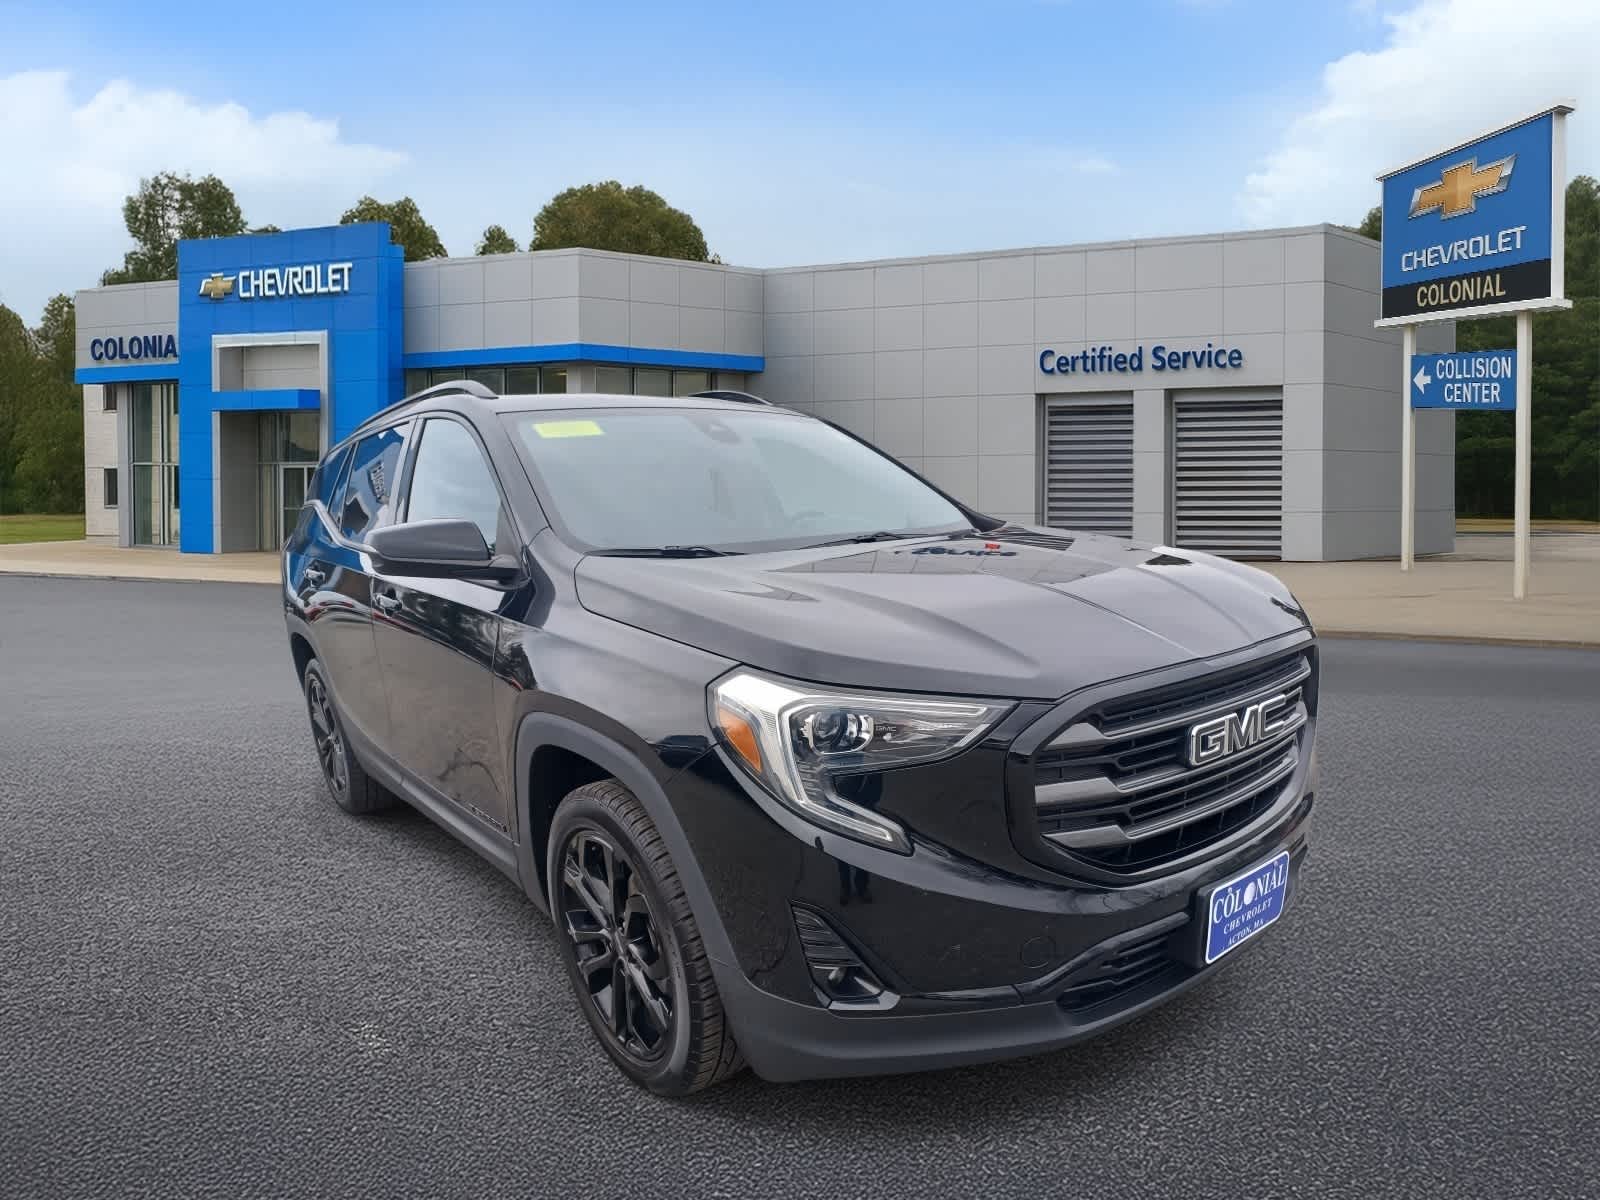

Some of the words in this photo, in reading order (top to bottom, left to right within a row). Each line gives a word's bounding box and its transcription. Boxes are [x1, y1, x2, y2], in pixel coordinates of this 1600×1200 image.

[1401, 225, 1528, 272] CHEVROLET
[238, 262, 353, 298] CHEVROLET
[1416, 273, 1506, 307] COLONIAL
[90, 334, 178, 361] COLONIA
[1039, 346, 1144, 374] Certified
[1151, 343, 1243, 371] Service
[1436, 356, 1512, 380] COLLISION
[1444, 383, 1501, 403] CENTER
[1190, 694, 1287, 766] GMC
[1213, 864, 1285, 923] COLONIAL
[1223, 897, 1273, 934] CHEVROLET
